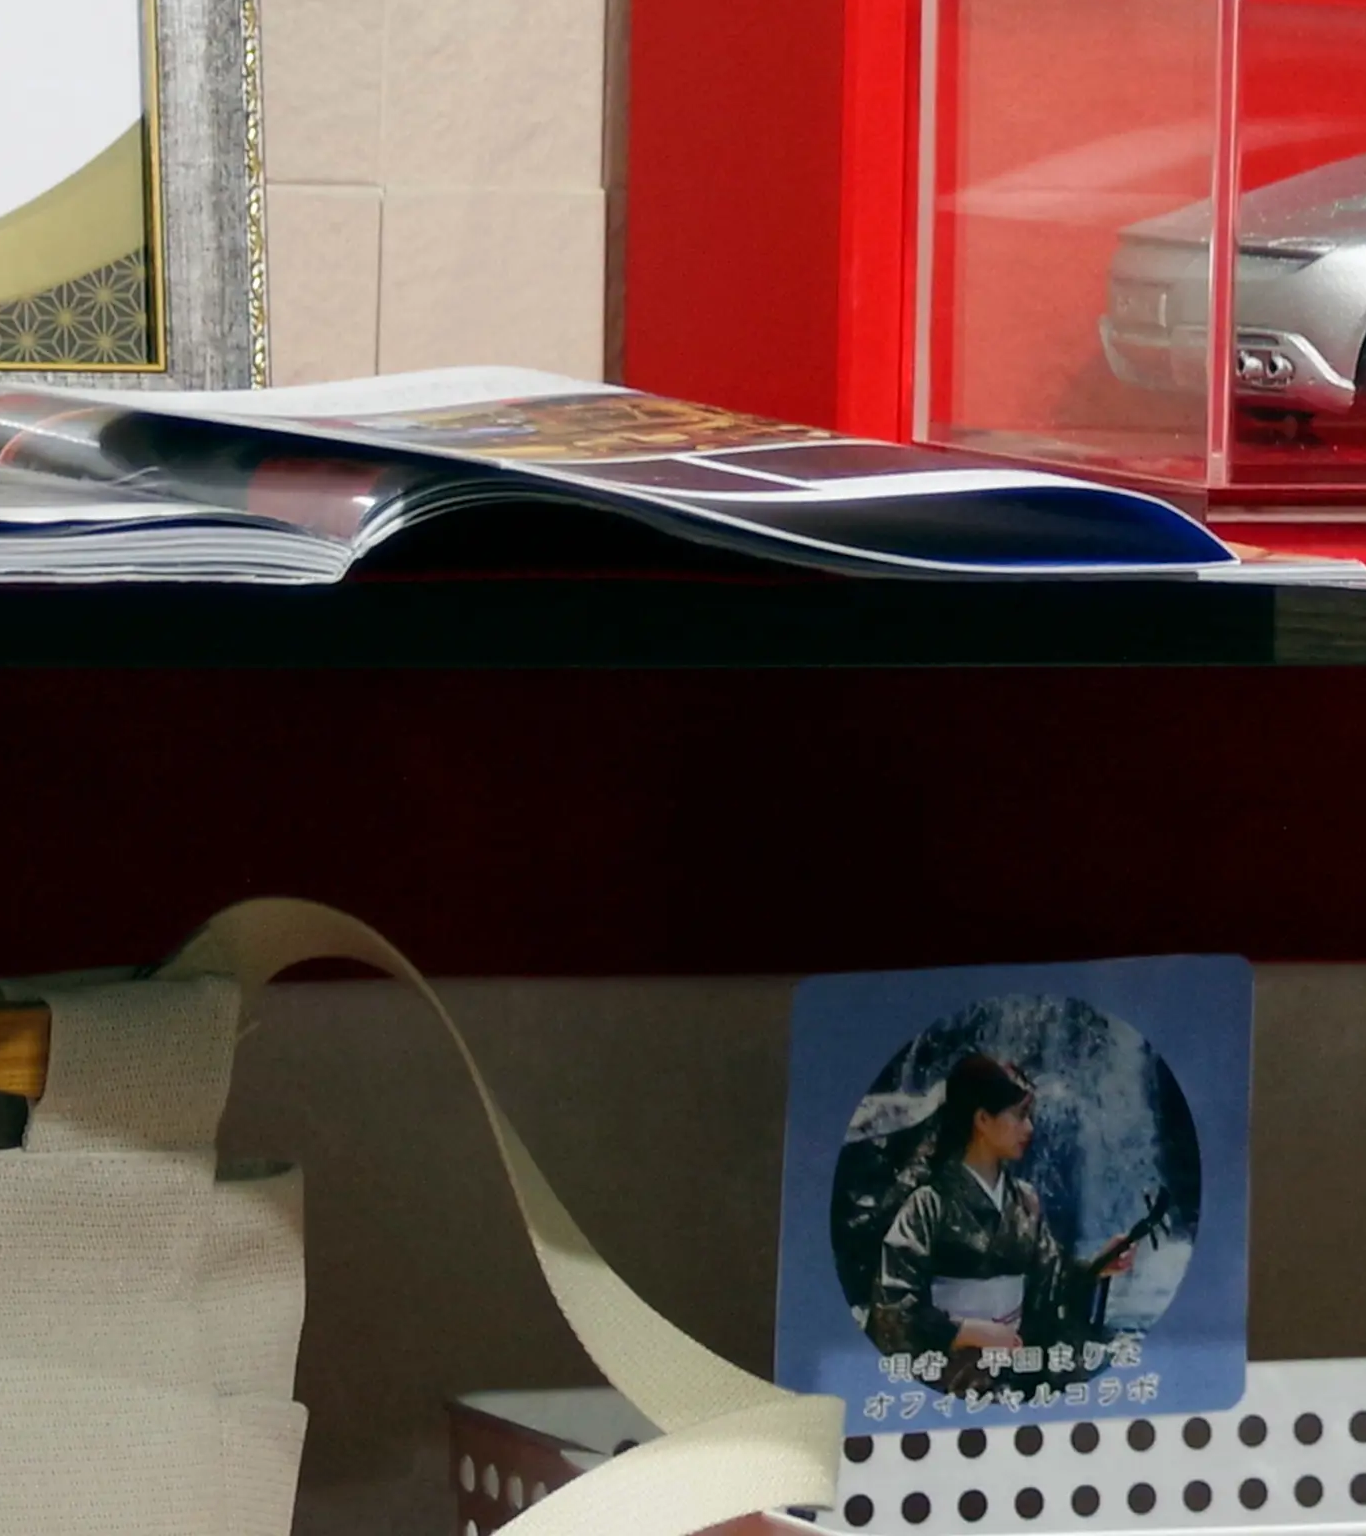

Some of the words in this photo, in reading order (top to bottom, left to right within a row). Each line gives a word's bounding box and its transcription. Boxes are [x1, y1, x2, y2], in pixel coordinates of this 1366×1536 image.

[863, 1373, 1160, 1420] オフィシャルコラボ
